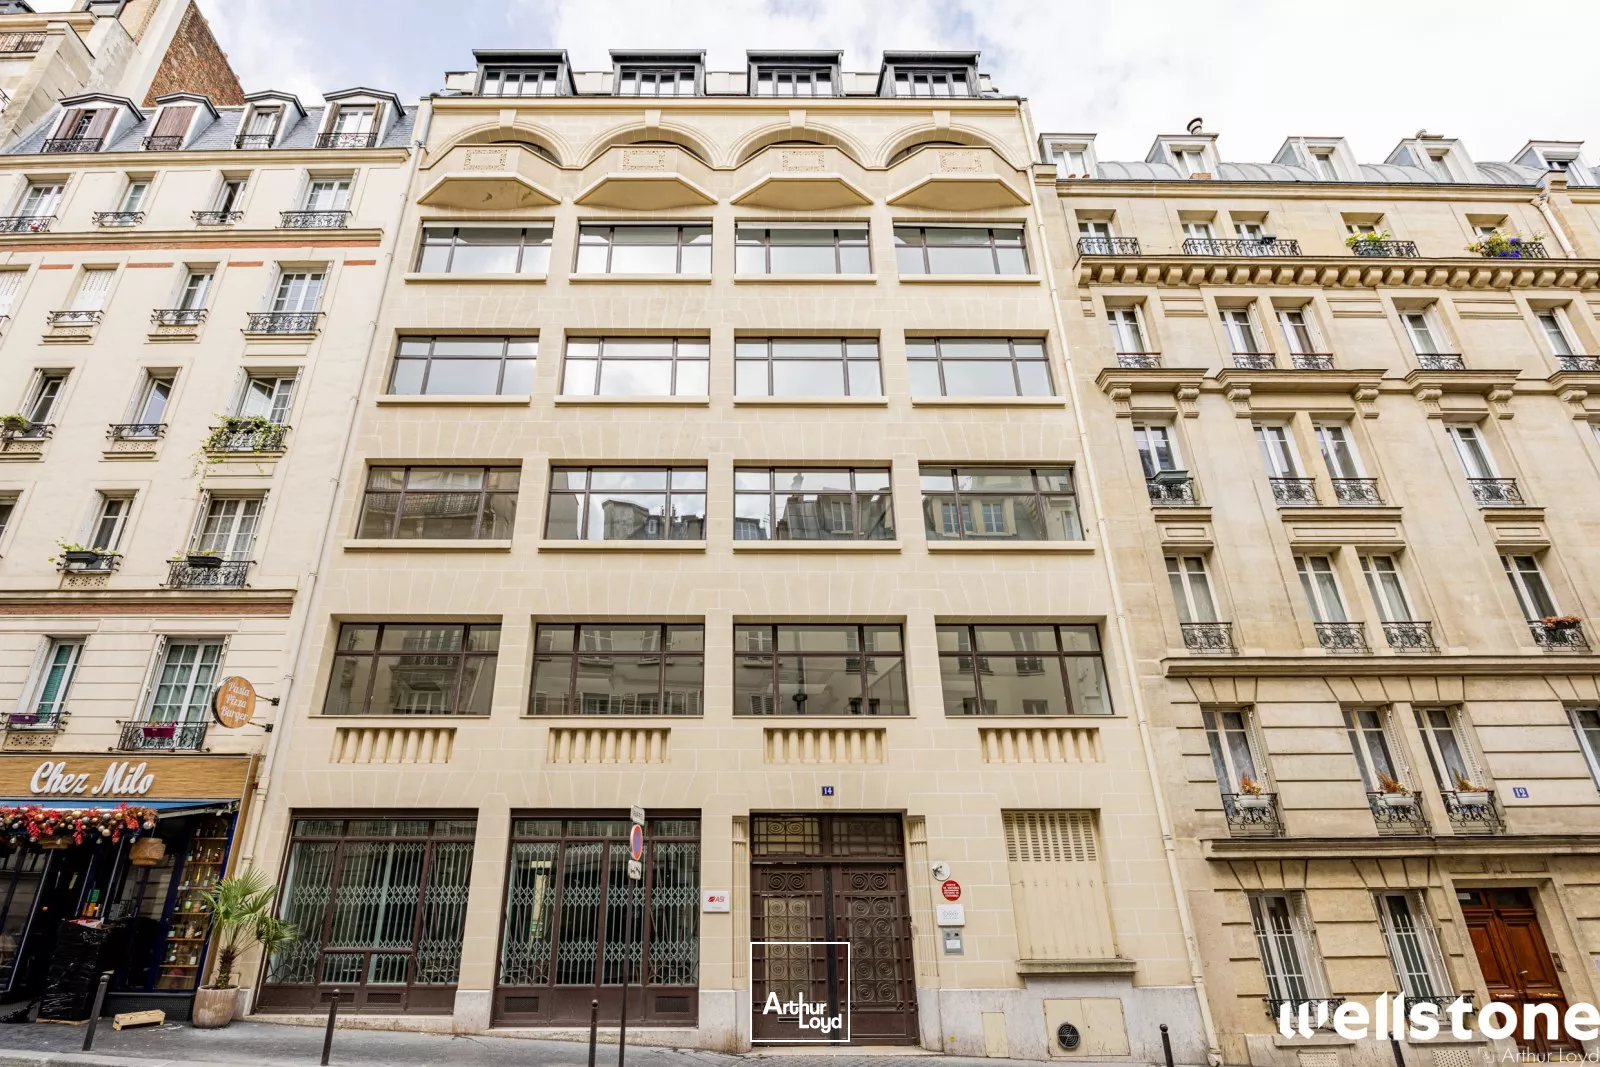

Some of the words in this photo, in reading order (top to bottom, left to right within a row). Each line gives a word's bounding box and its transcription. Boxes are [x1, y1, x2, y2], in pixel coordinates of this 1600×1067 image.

[228, 682, 250, 697] Pasta
[225, 694, 248, 709] Pizza
[220, 705, 249, 722] Burger
[30, 761, 90, 794] Chez
[91, 761, 155, 795] Milo
[1514, 787, 1527, 798] 12
